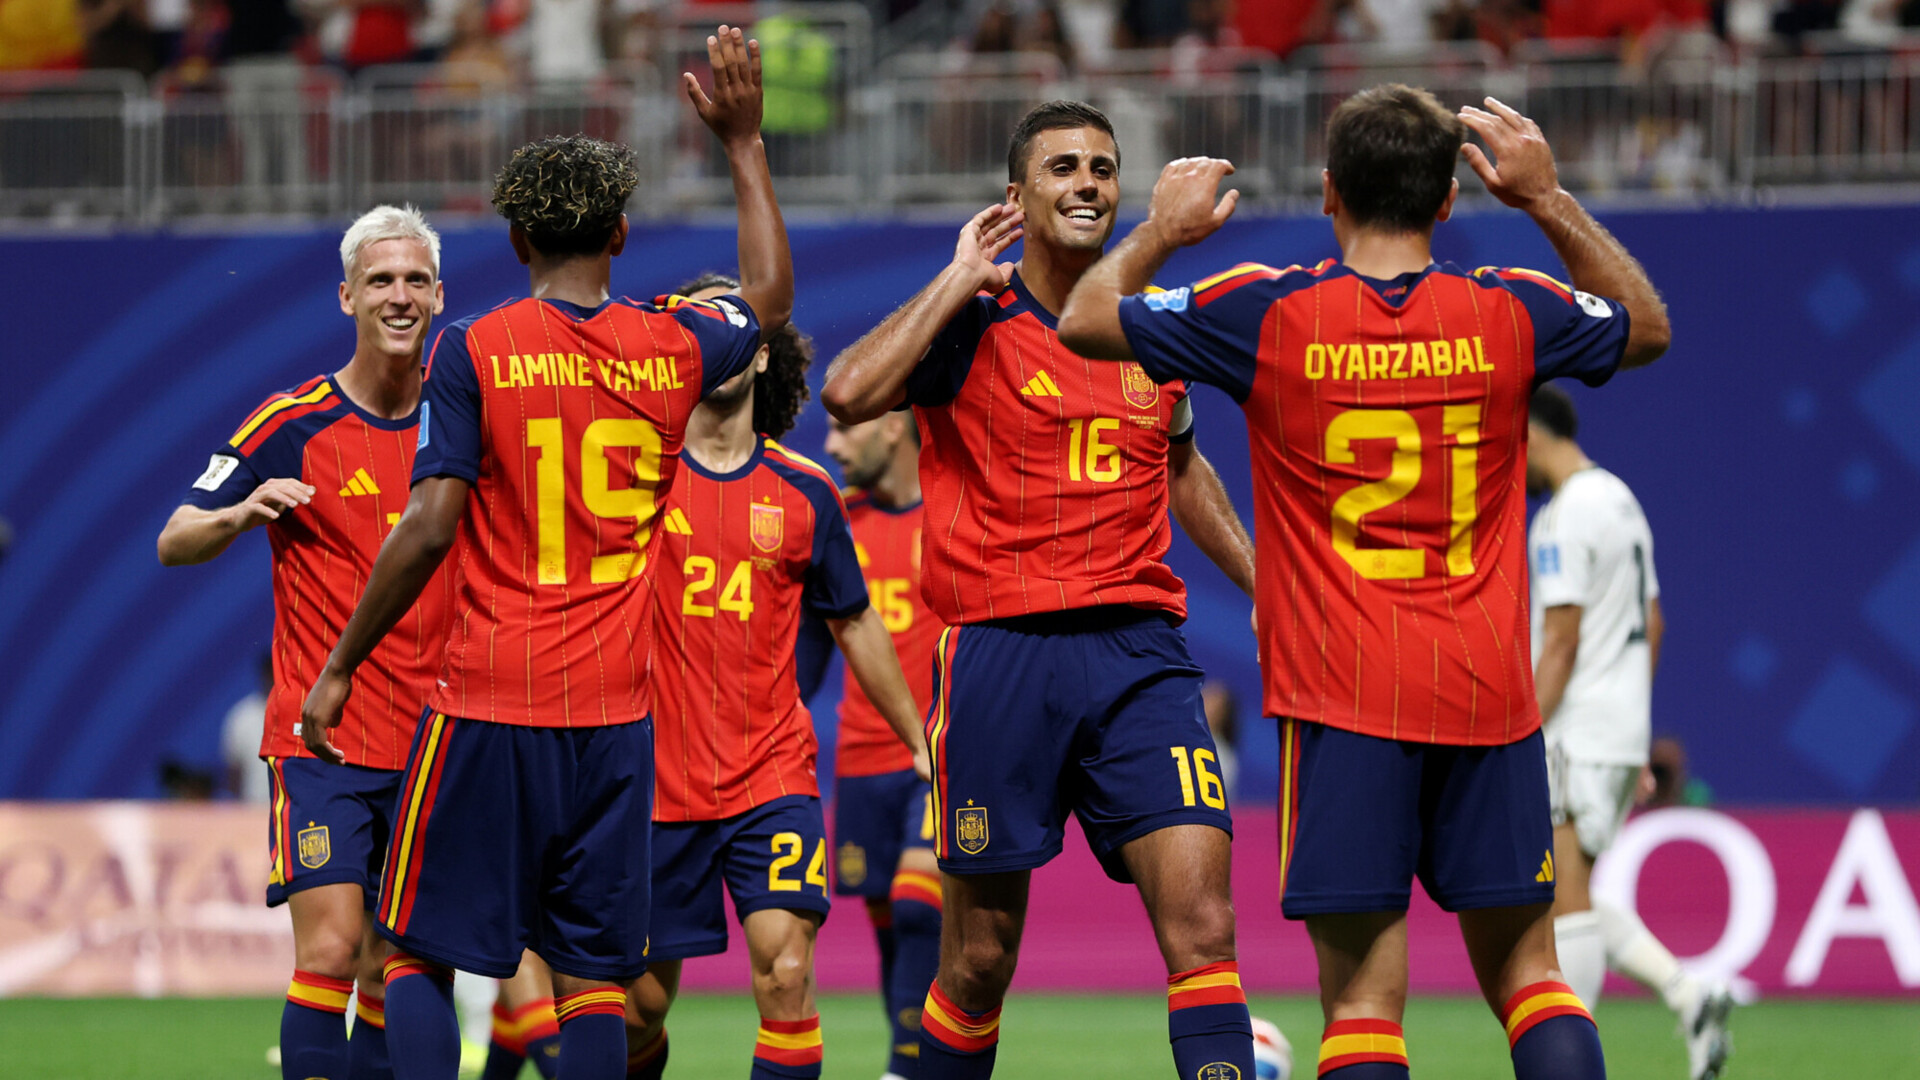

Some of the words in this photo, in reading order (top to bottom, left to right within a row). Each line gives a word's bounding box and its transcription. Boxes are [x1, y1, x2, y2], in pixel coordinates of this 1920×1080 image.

[490, 353, 594, 388] LAMINE
[596, 356, 684, 391] YAMAL
[1305, 337, 1495, 380] OYARZABAL
[1068, 418, 1120, 482] 16
[527, 417, 662, 585] 19
[1325, 405, 1481, 580] 21
[682, 555, 754, 621] 24
[1170, 746, 1225, 810] 16
[769, 832, 827, 898] 24
[1589, 806, 1920, 1006] QA
